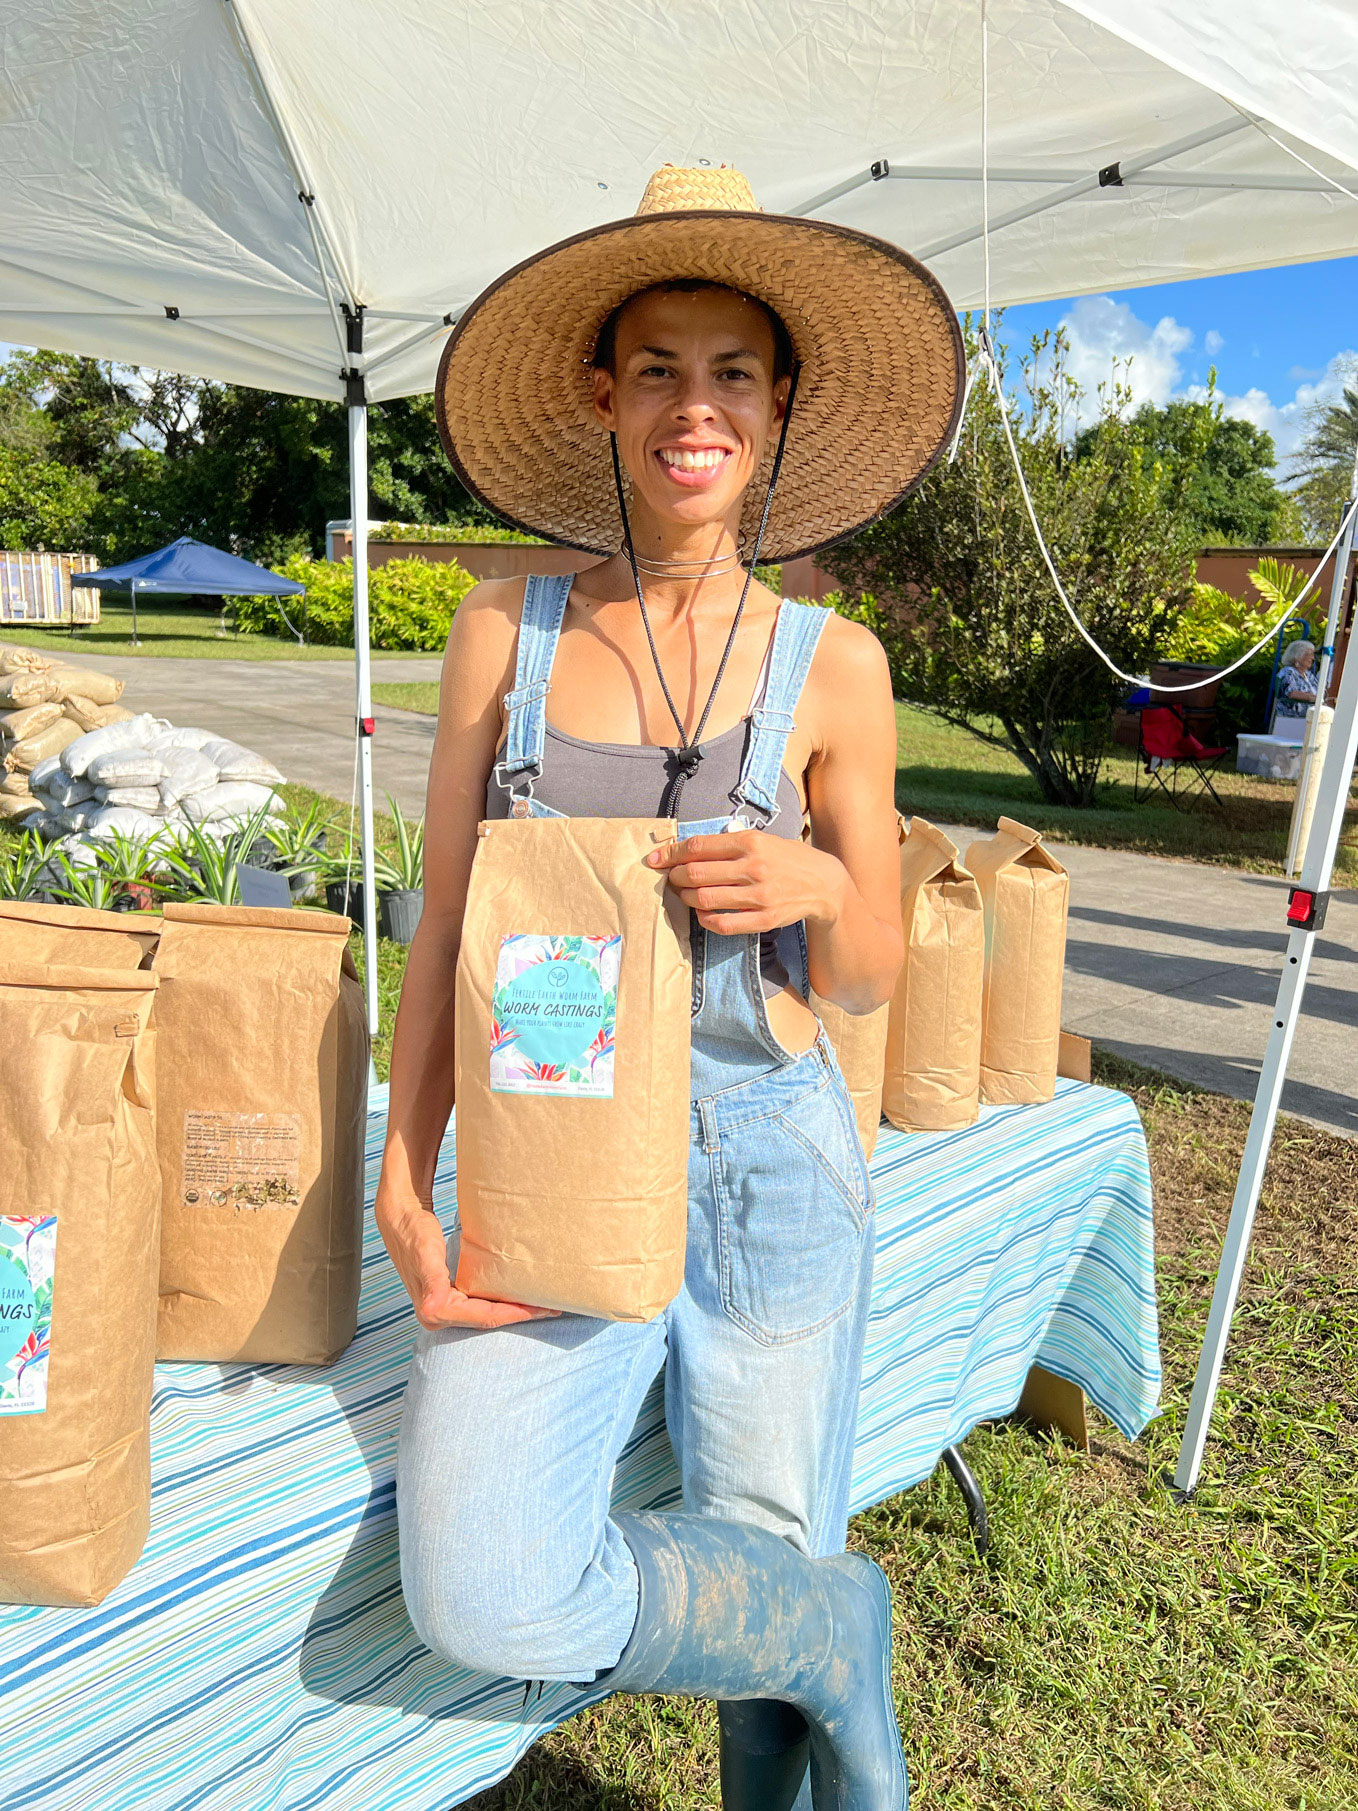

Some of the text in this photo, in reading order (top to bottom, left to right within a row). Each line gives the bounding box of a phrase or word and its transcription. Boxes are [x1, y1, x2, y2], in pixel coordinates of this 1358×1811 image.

[538, 989, 557, 1000] EARTH
[559, 990, 578, 1001] WORM
[580, 991, 598, 1002] FARM
[503, 1002, 603, 1017] WORM CASTINGS
[2, 1287, 25, 1300] FARM
